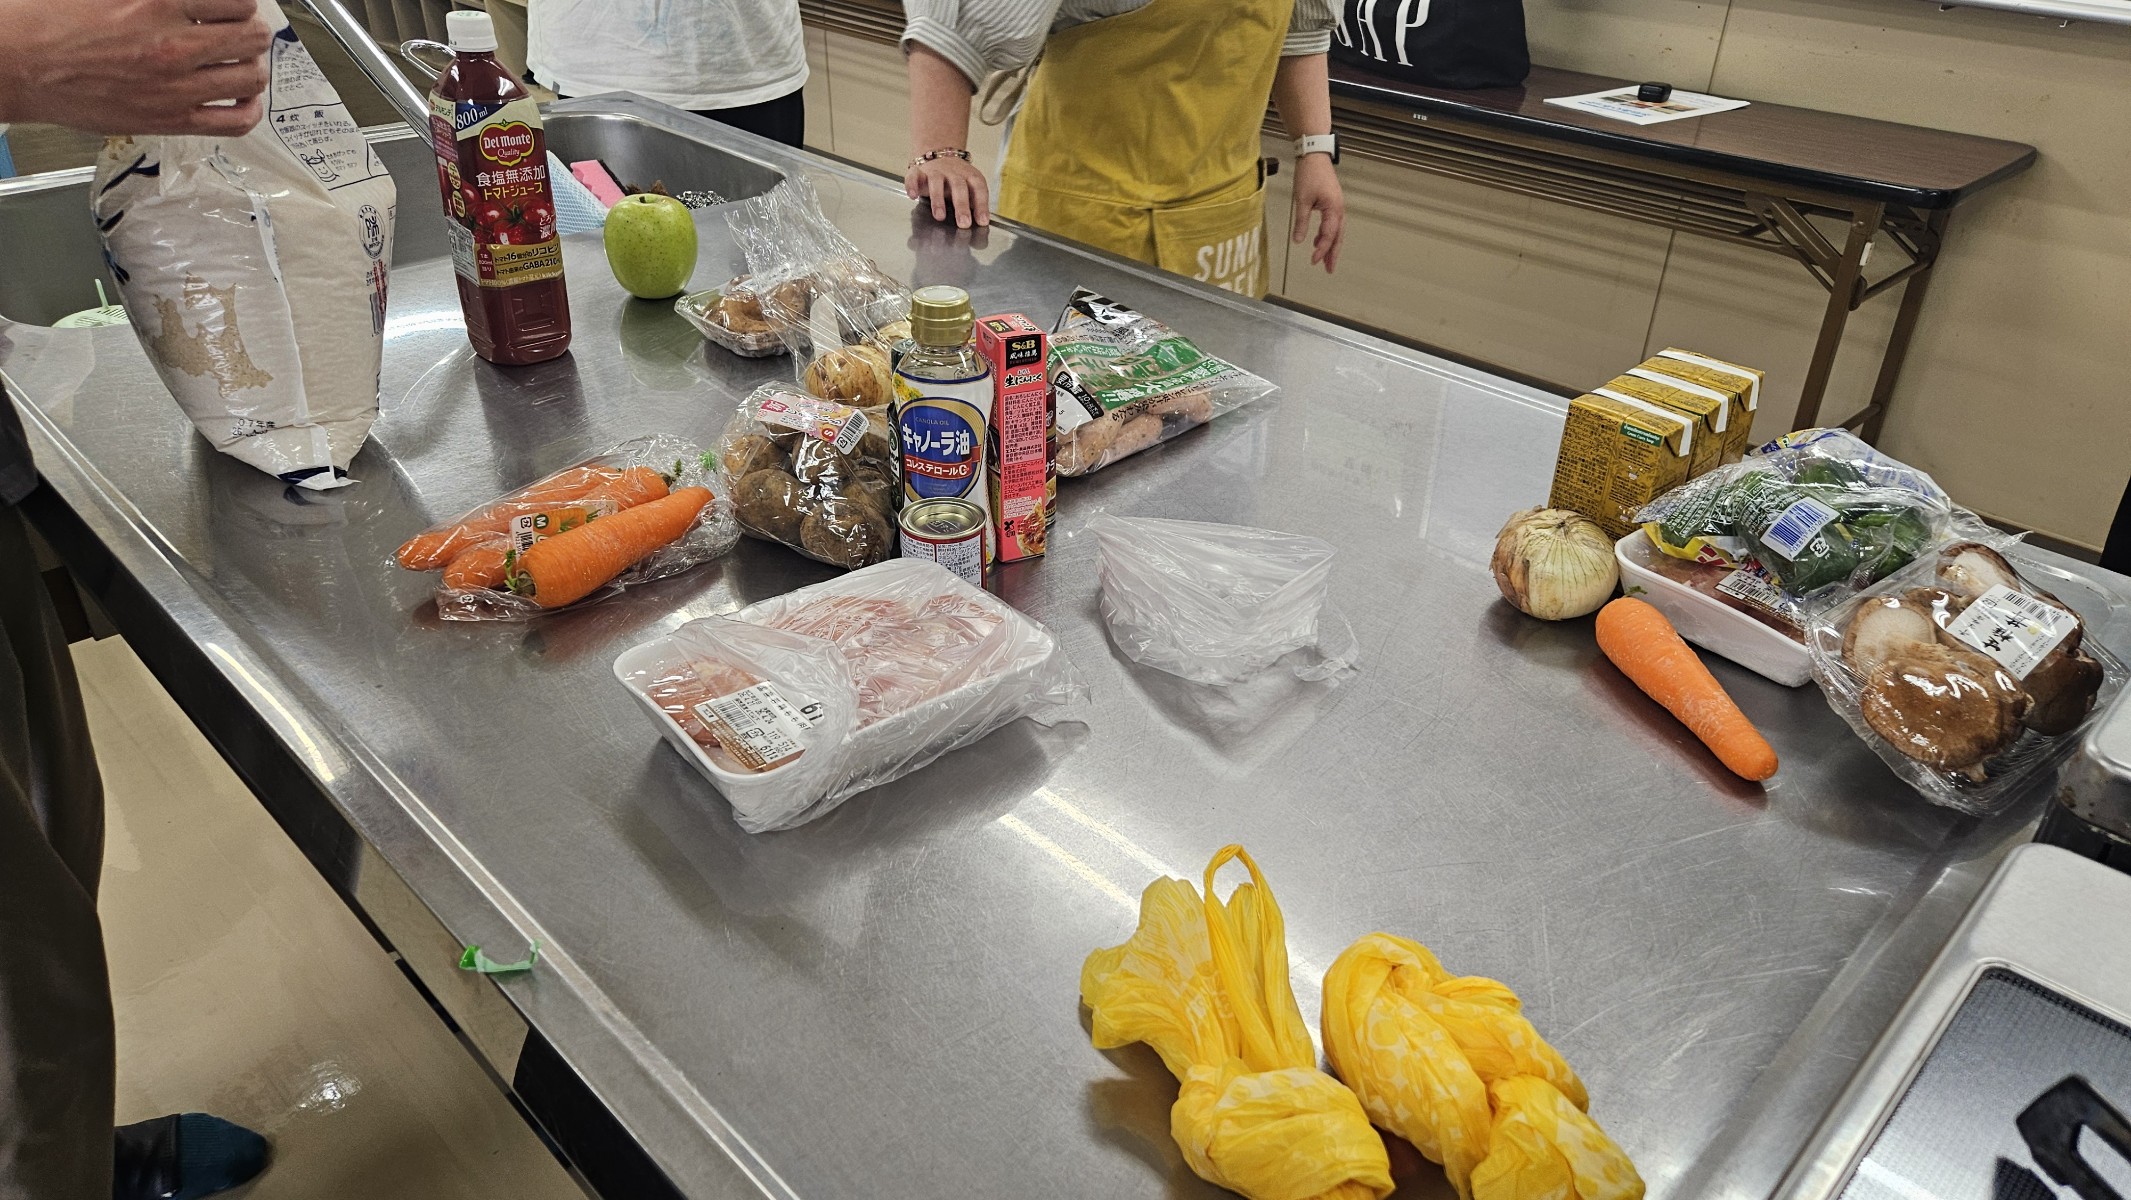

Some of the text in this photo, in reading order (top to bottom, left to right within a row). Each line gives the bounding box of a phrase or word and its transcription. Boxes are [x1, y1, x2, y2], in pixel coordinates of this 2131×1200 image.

[276, 115, 285, 123] 4
[456, 106, 488, 130] 800 ml
[483, 133, 531, 149] Del Monte
[497, 148, 520, 158] Quality
[475, 164, 546, 187] 食塩無添加
[483, 182, 543, 201] トマトジュース
[1011, 339, 1036, 351] S&B
[1004, 371, 1043, 389] 生にんにく
[824, 429, 834, 438] S
[902, 423, 970, 456] キャノーラ油
[536, 516, 546, 528] M
